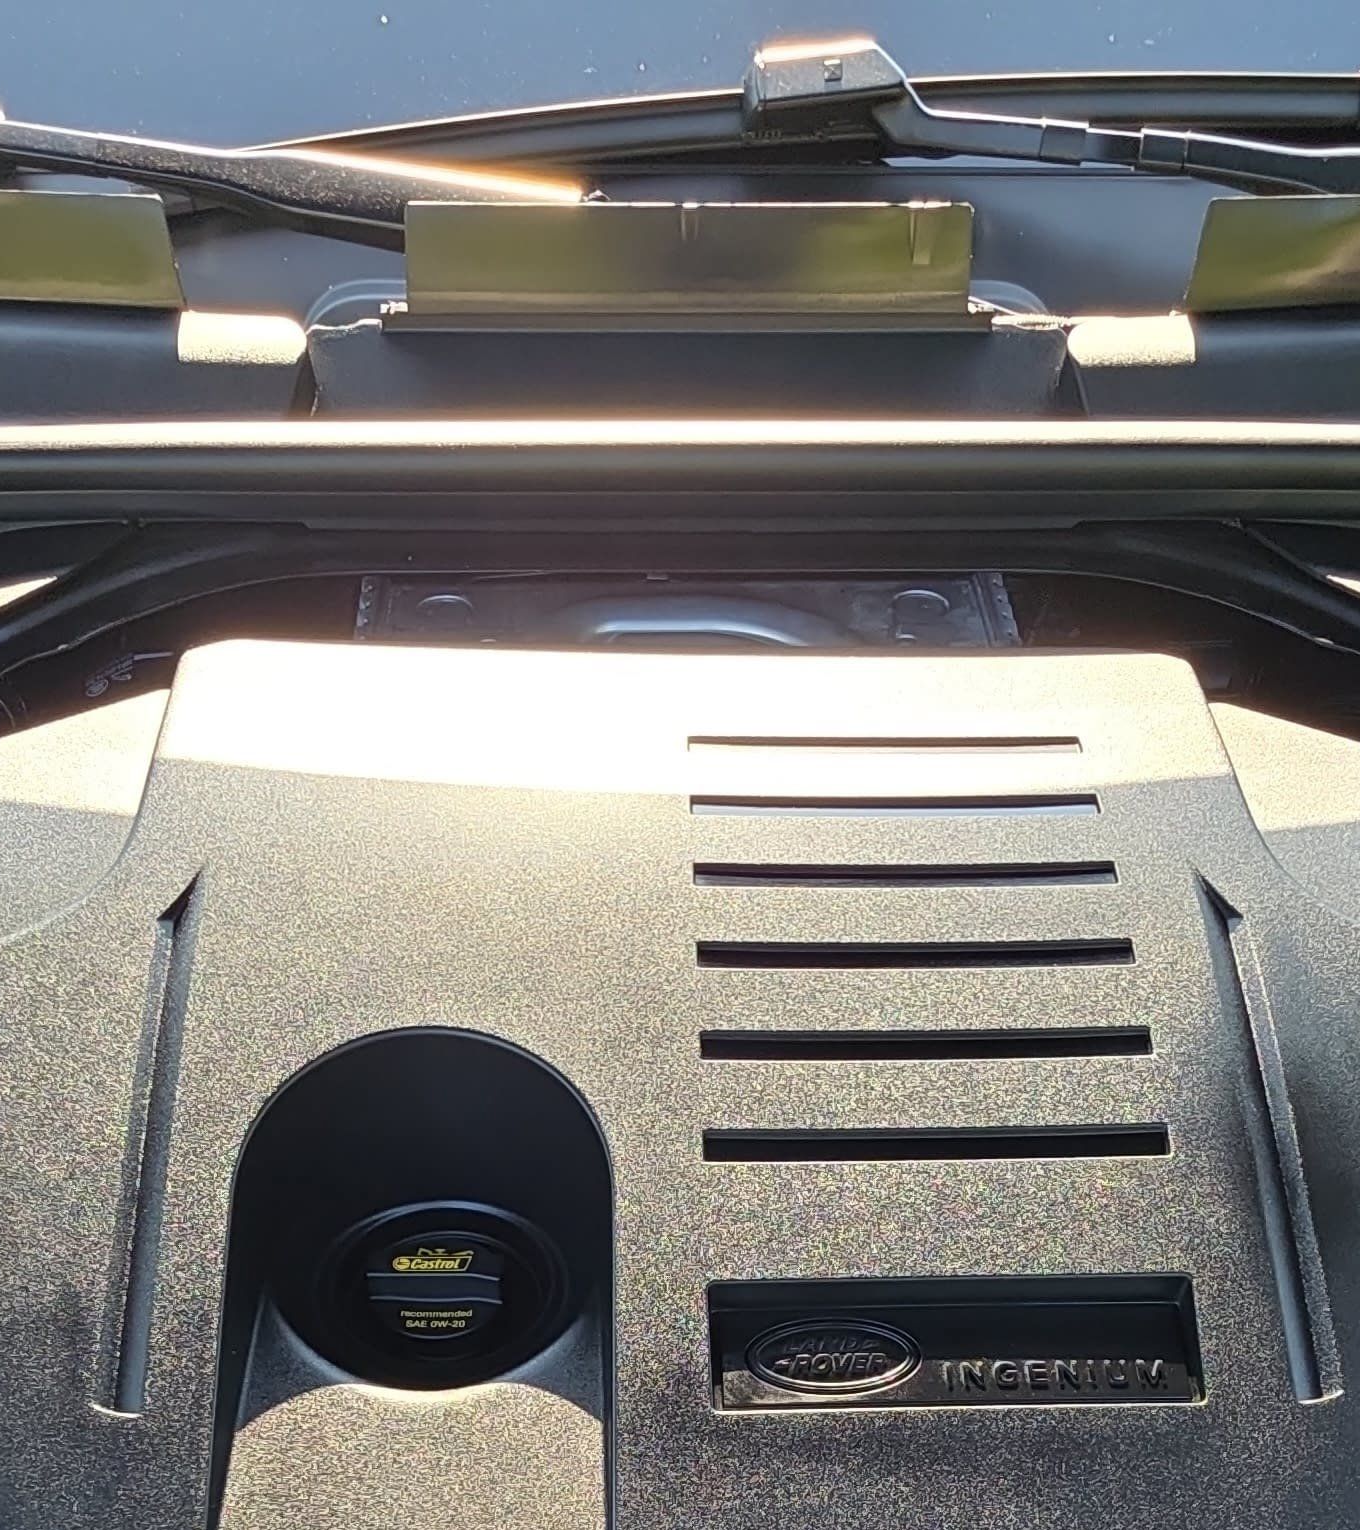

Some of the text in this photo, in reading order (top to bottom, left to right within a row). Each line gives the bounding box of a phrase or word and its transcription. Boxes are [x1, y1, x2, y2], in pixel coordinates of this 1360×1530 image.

[409, 1257, 461, 1270] Castrol
[400, 1308, 473, 1318] recommended
[405, 1319, 466, 1328] SAE 0W-20
[788, 1352, 888, 1375] ROVER
[940, 1358, 1168, 1392] INGENIUM
